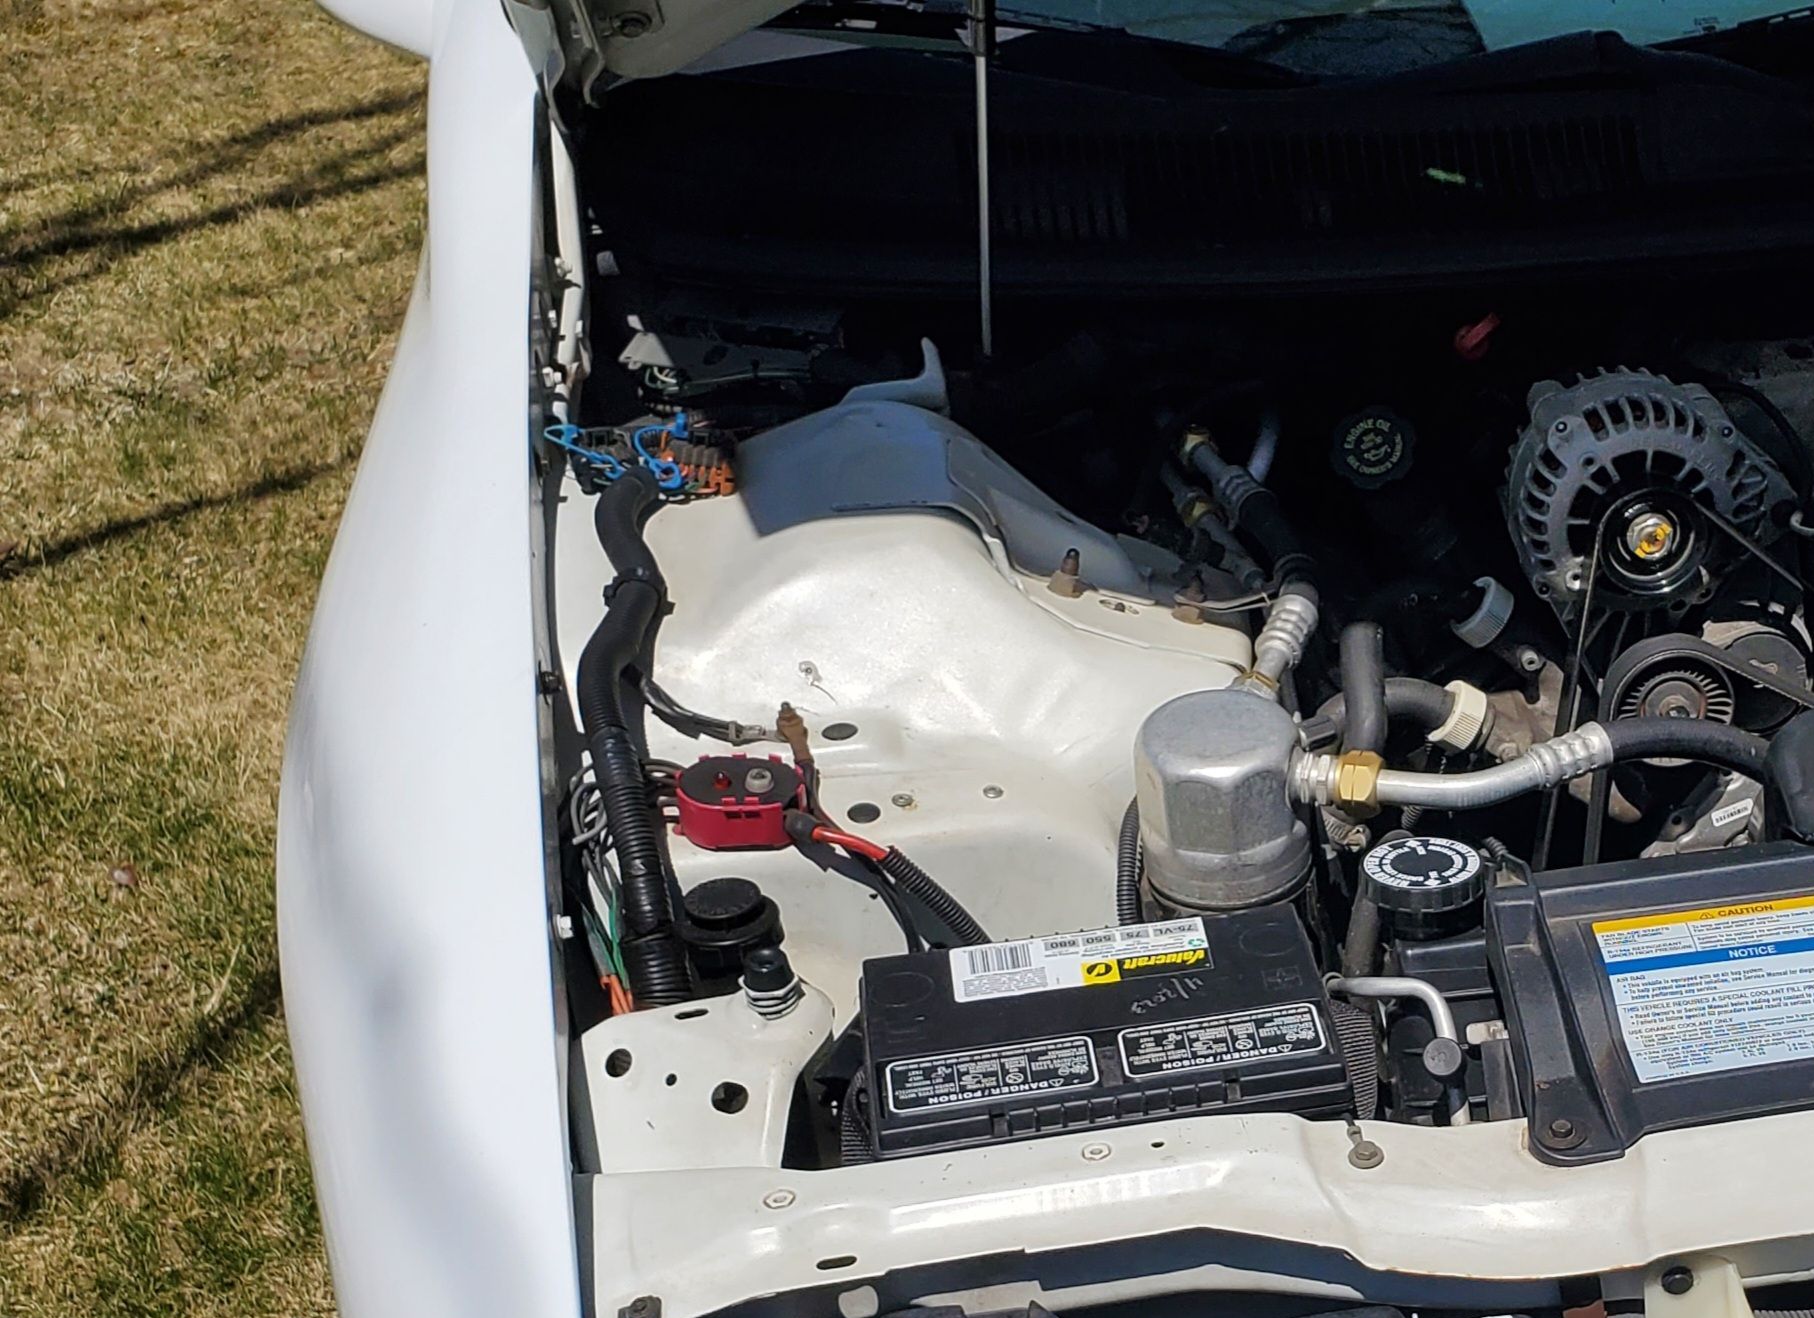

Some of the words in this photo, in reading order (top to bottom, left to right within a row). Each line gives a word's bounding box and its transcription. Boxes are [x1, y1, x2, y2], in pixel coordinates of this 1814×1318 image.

[1717, 904, 1774, 918] CAUTION
[1126, 931, 1142, 939] 75
[1154, 924, 1193, 935] 75-VL
[1050, 940, 1076, 949] 680
[1086, 935, 1111, 945] 550
[1728, 945, 1778, 959] NOTICE
[1122, 948, 1206, 974] Valucraft
[1622, 1006, 1640, 1014] THIS
[1640, 1002, 1671, 1012] VEHICLE
[1672, 997, 1710, 1008] REQUIRES
[1718, 992, 1749, 1002] SPECIAL
[1749, 987, 1785, 998] COOLANT
[1786, 985, 1802, 993] FILL
[1644, 1025, 1676, 1034] ORANGE
[1677, 1020, 1713, 1029] COOLANT
[1222, 1046, 1277, 1060] DANGER
[1162, 1056, 1213, 1069] POISON
[990, 1079, 1048, 1094] DANGER
[928, 1090, 982, 1104] POISON
